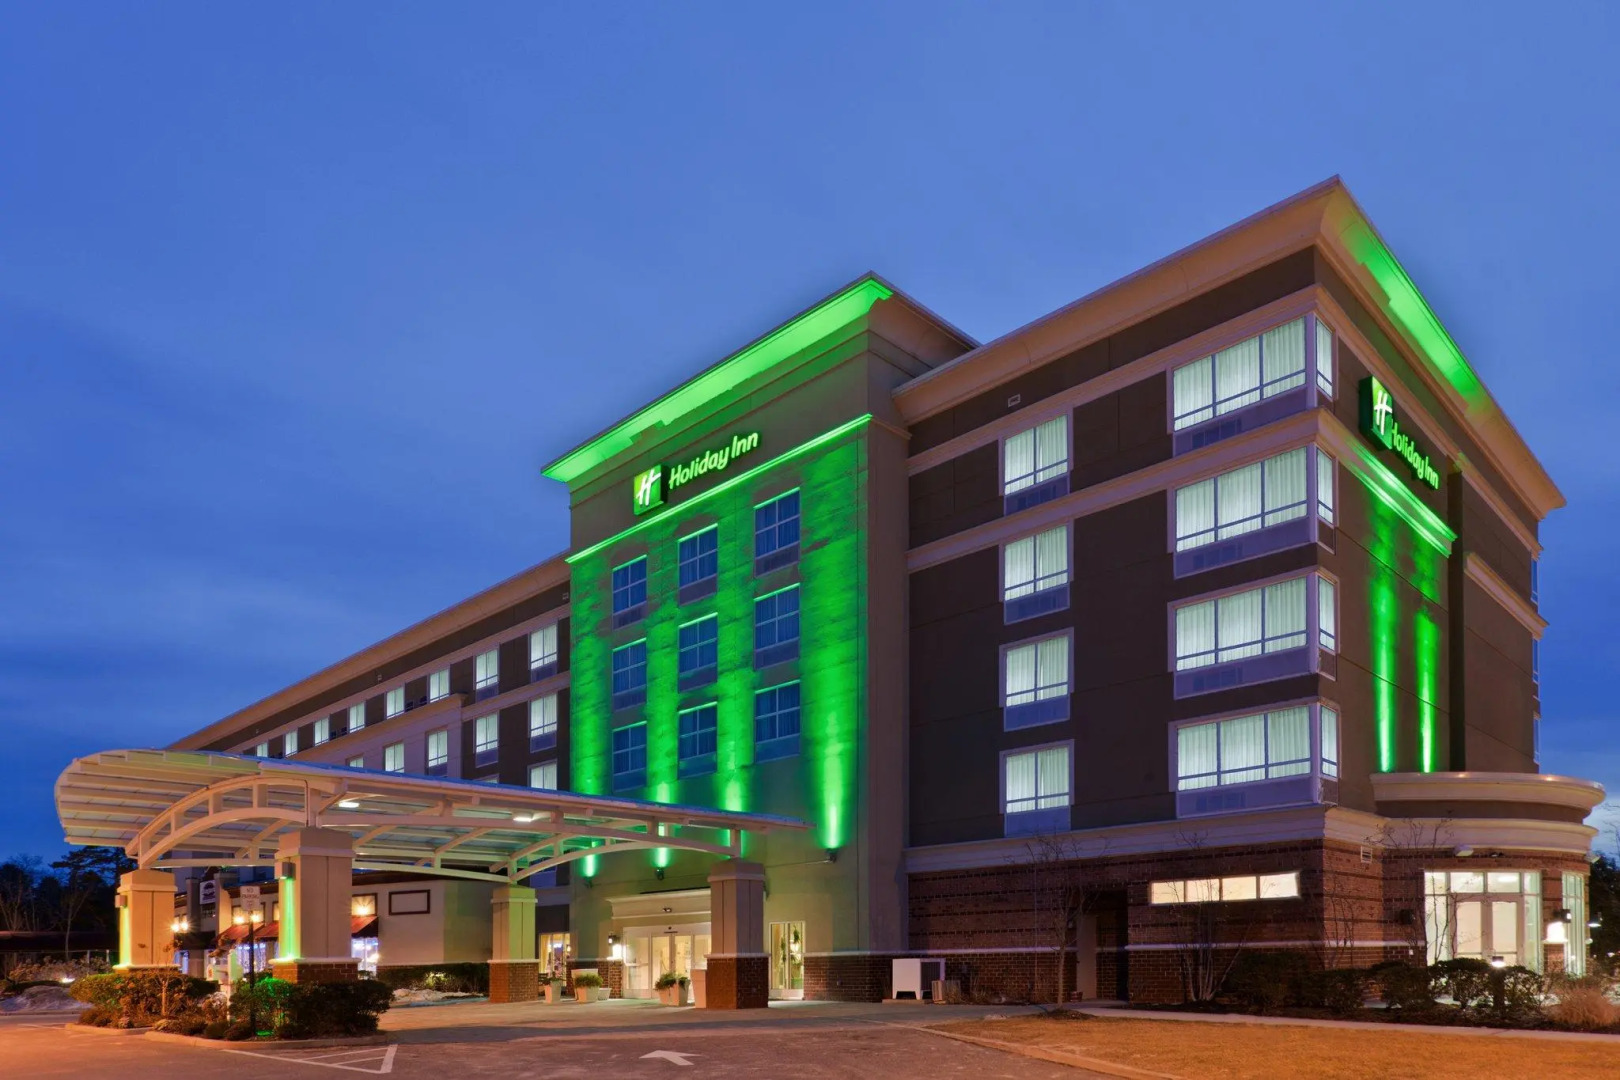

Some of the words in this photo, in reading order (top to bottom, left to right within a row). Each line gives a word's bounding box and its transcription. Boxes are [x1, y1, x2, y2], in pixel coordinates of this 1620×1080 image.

[668, 447, 730, 490] Holiday
[731, 432, 759, 459] Inn
[1425, 456, 1439, 490] Inn
